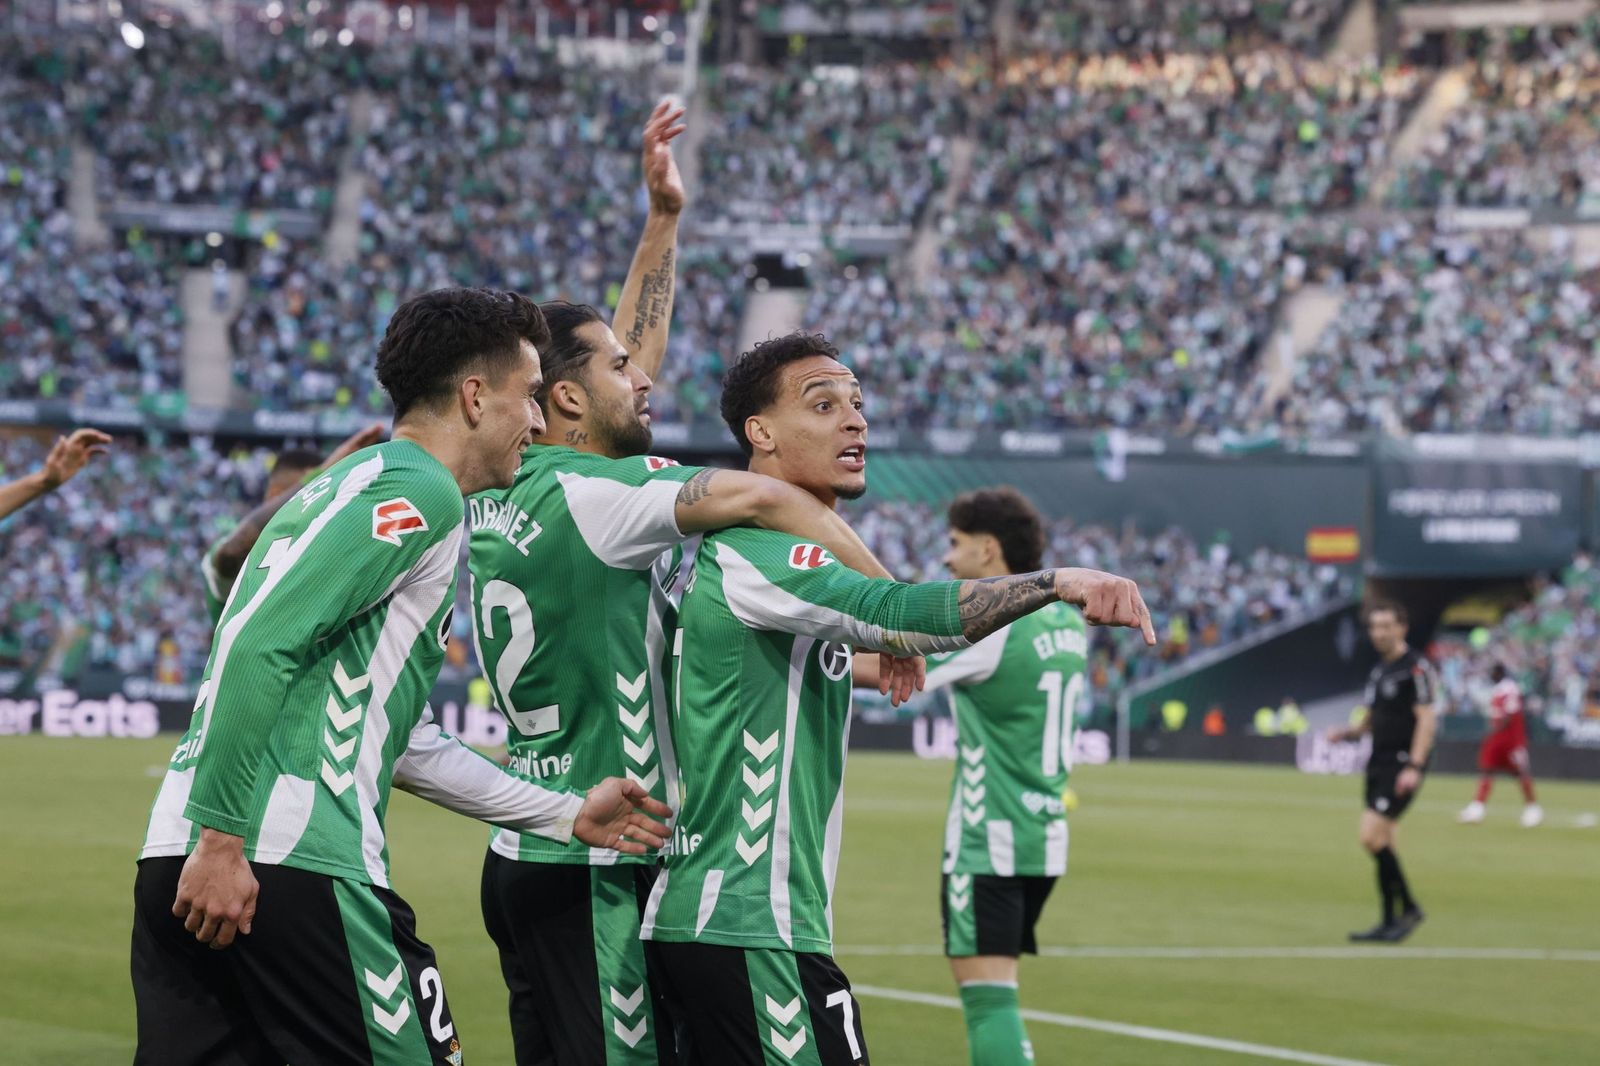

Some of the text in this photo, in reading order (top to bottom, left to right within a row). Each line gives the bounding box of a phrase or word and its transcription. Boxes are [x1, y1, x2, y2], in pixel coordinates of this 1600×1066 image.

[42, 689, 160, 738] Eats
[419, 966, 453, 1043] 2
[825, 989, 862, 1060] 7
